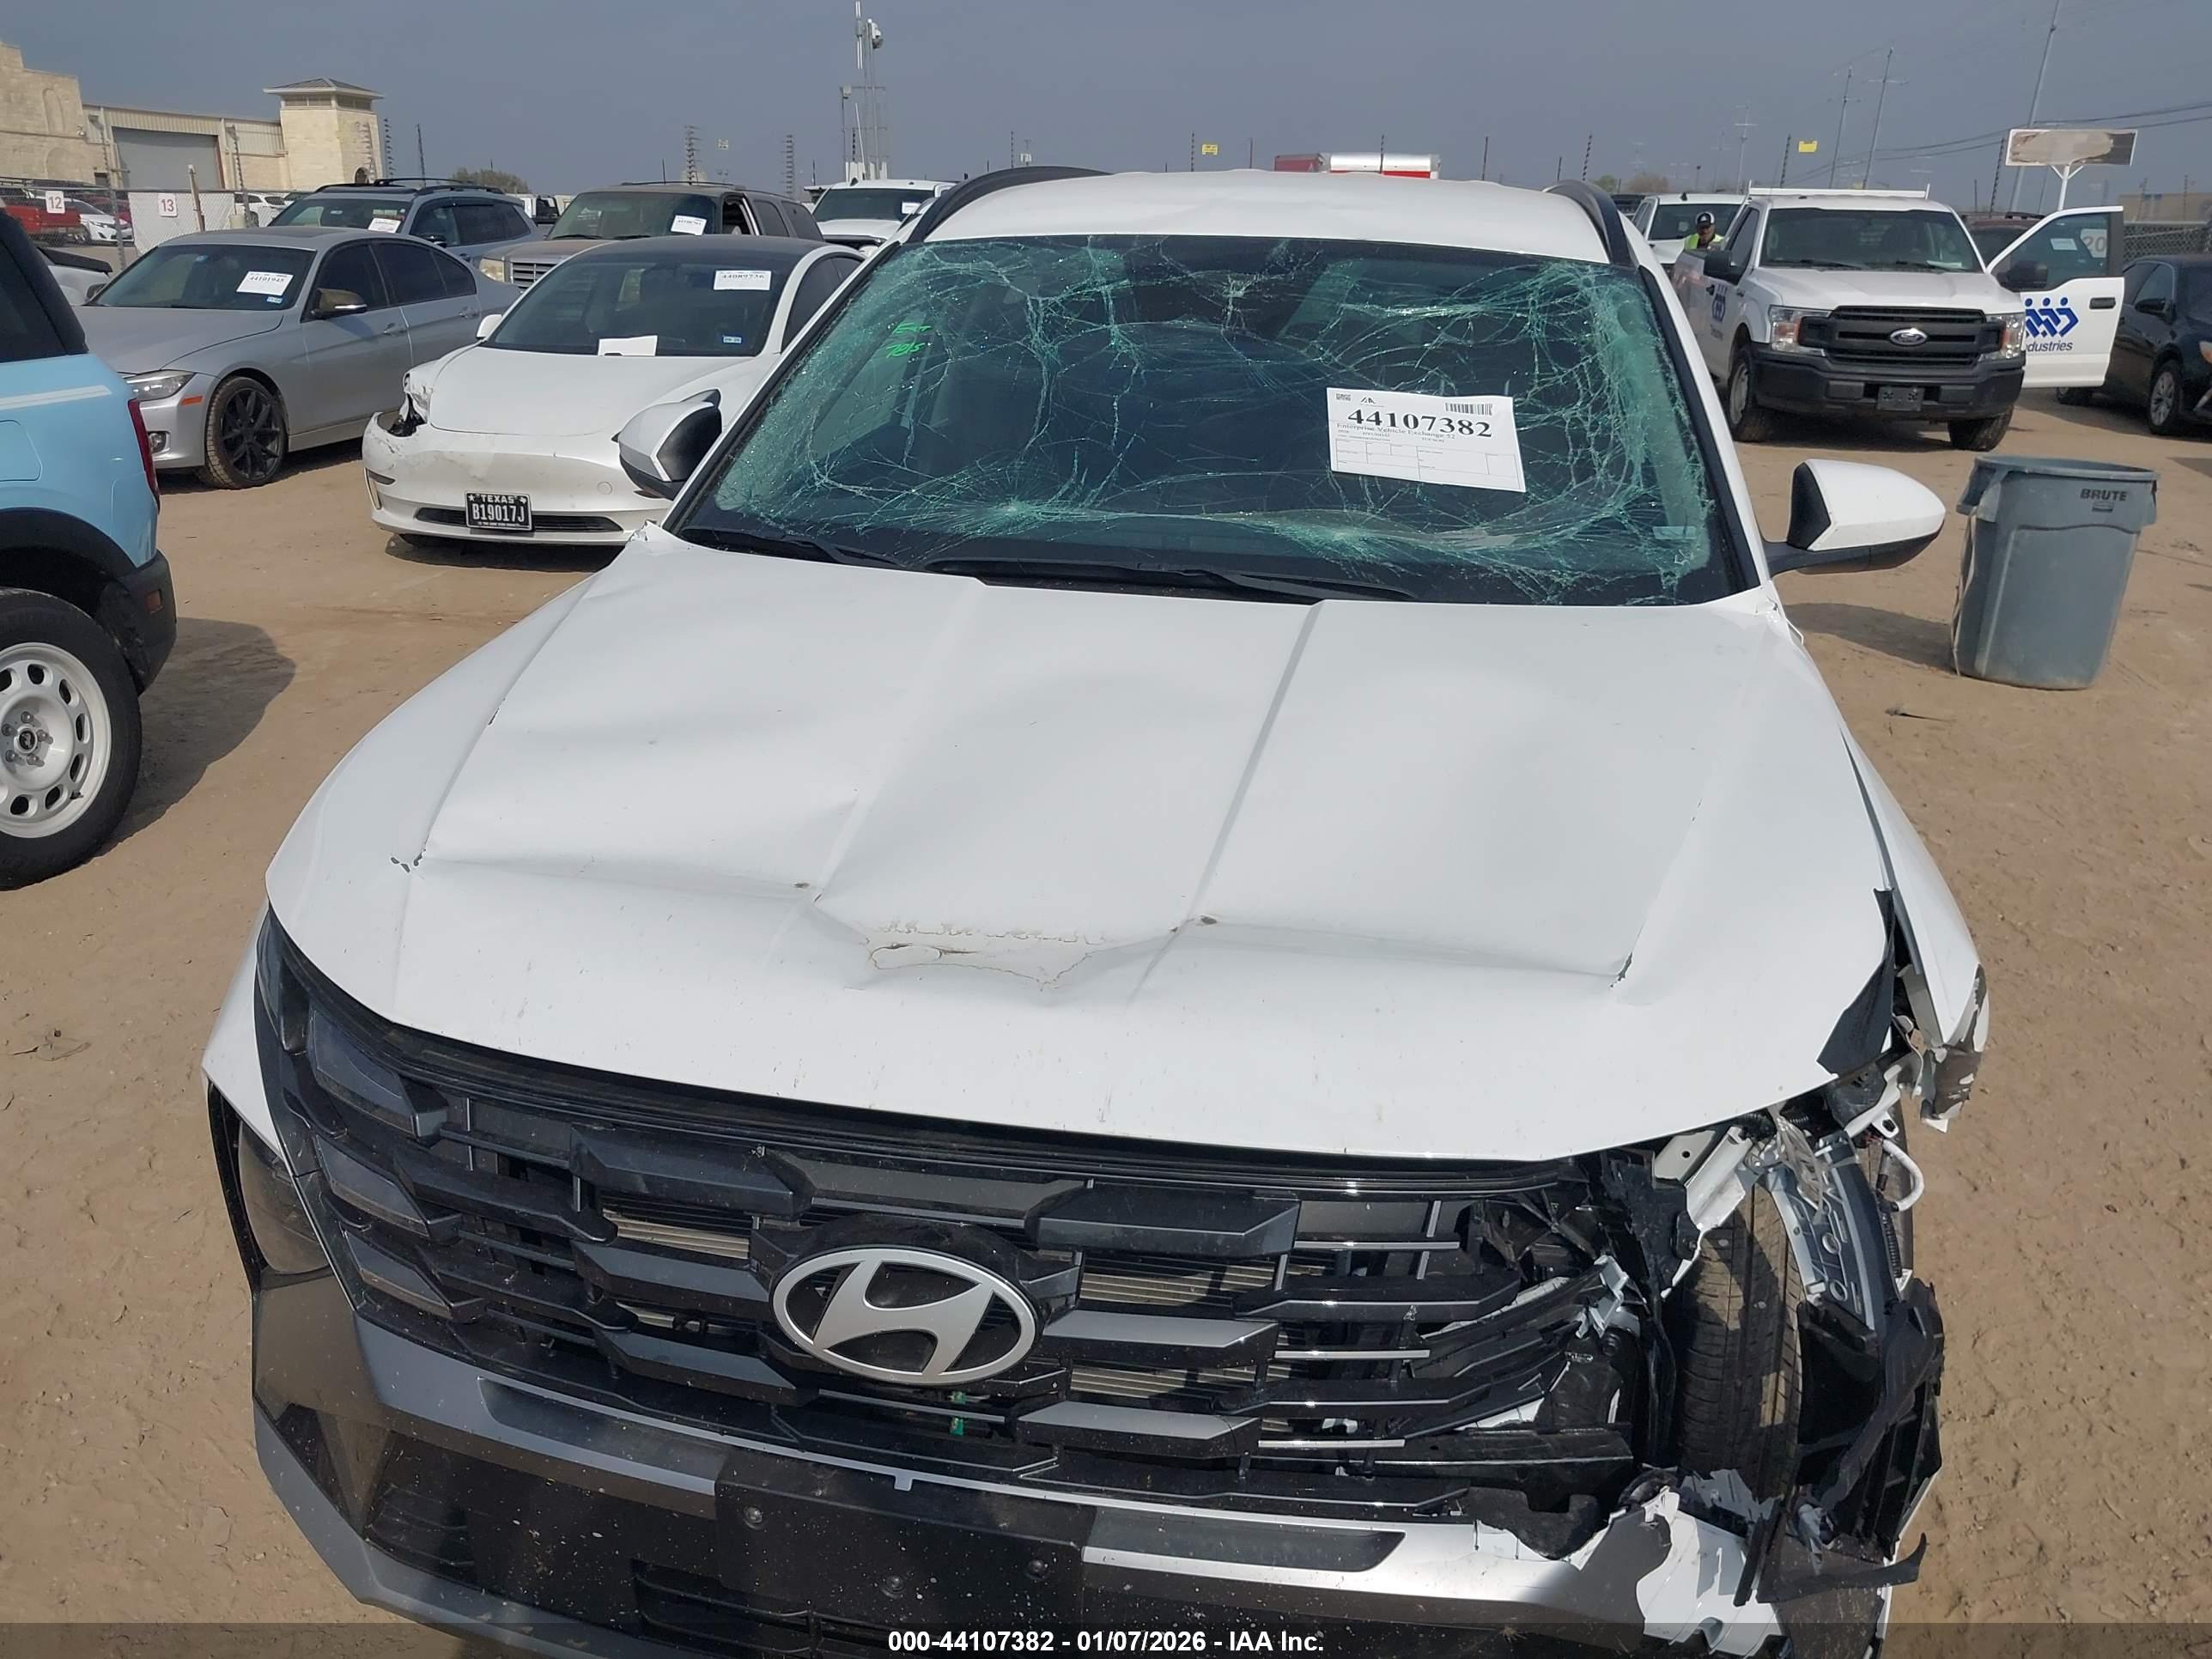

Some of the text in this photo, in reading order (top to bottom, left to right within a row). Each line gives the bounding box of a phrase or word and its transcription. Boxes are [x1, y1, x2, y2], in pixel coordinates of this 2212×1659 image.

[48, 196, 63, 210] 12
[161, 198, 174, 212] 13
[2025, 340, 2074, 352] dustries
[1336, 422, 1376, 431] Enterprise
[1347, 409, 1492, 437] 44107382
[481, 494, 515, 504] TEXAS
[2080, 488, 2129, 501] BRUTE
[471, 503, 525, 523] B19017J
